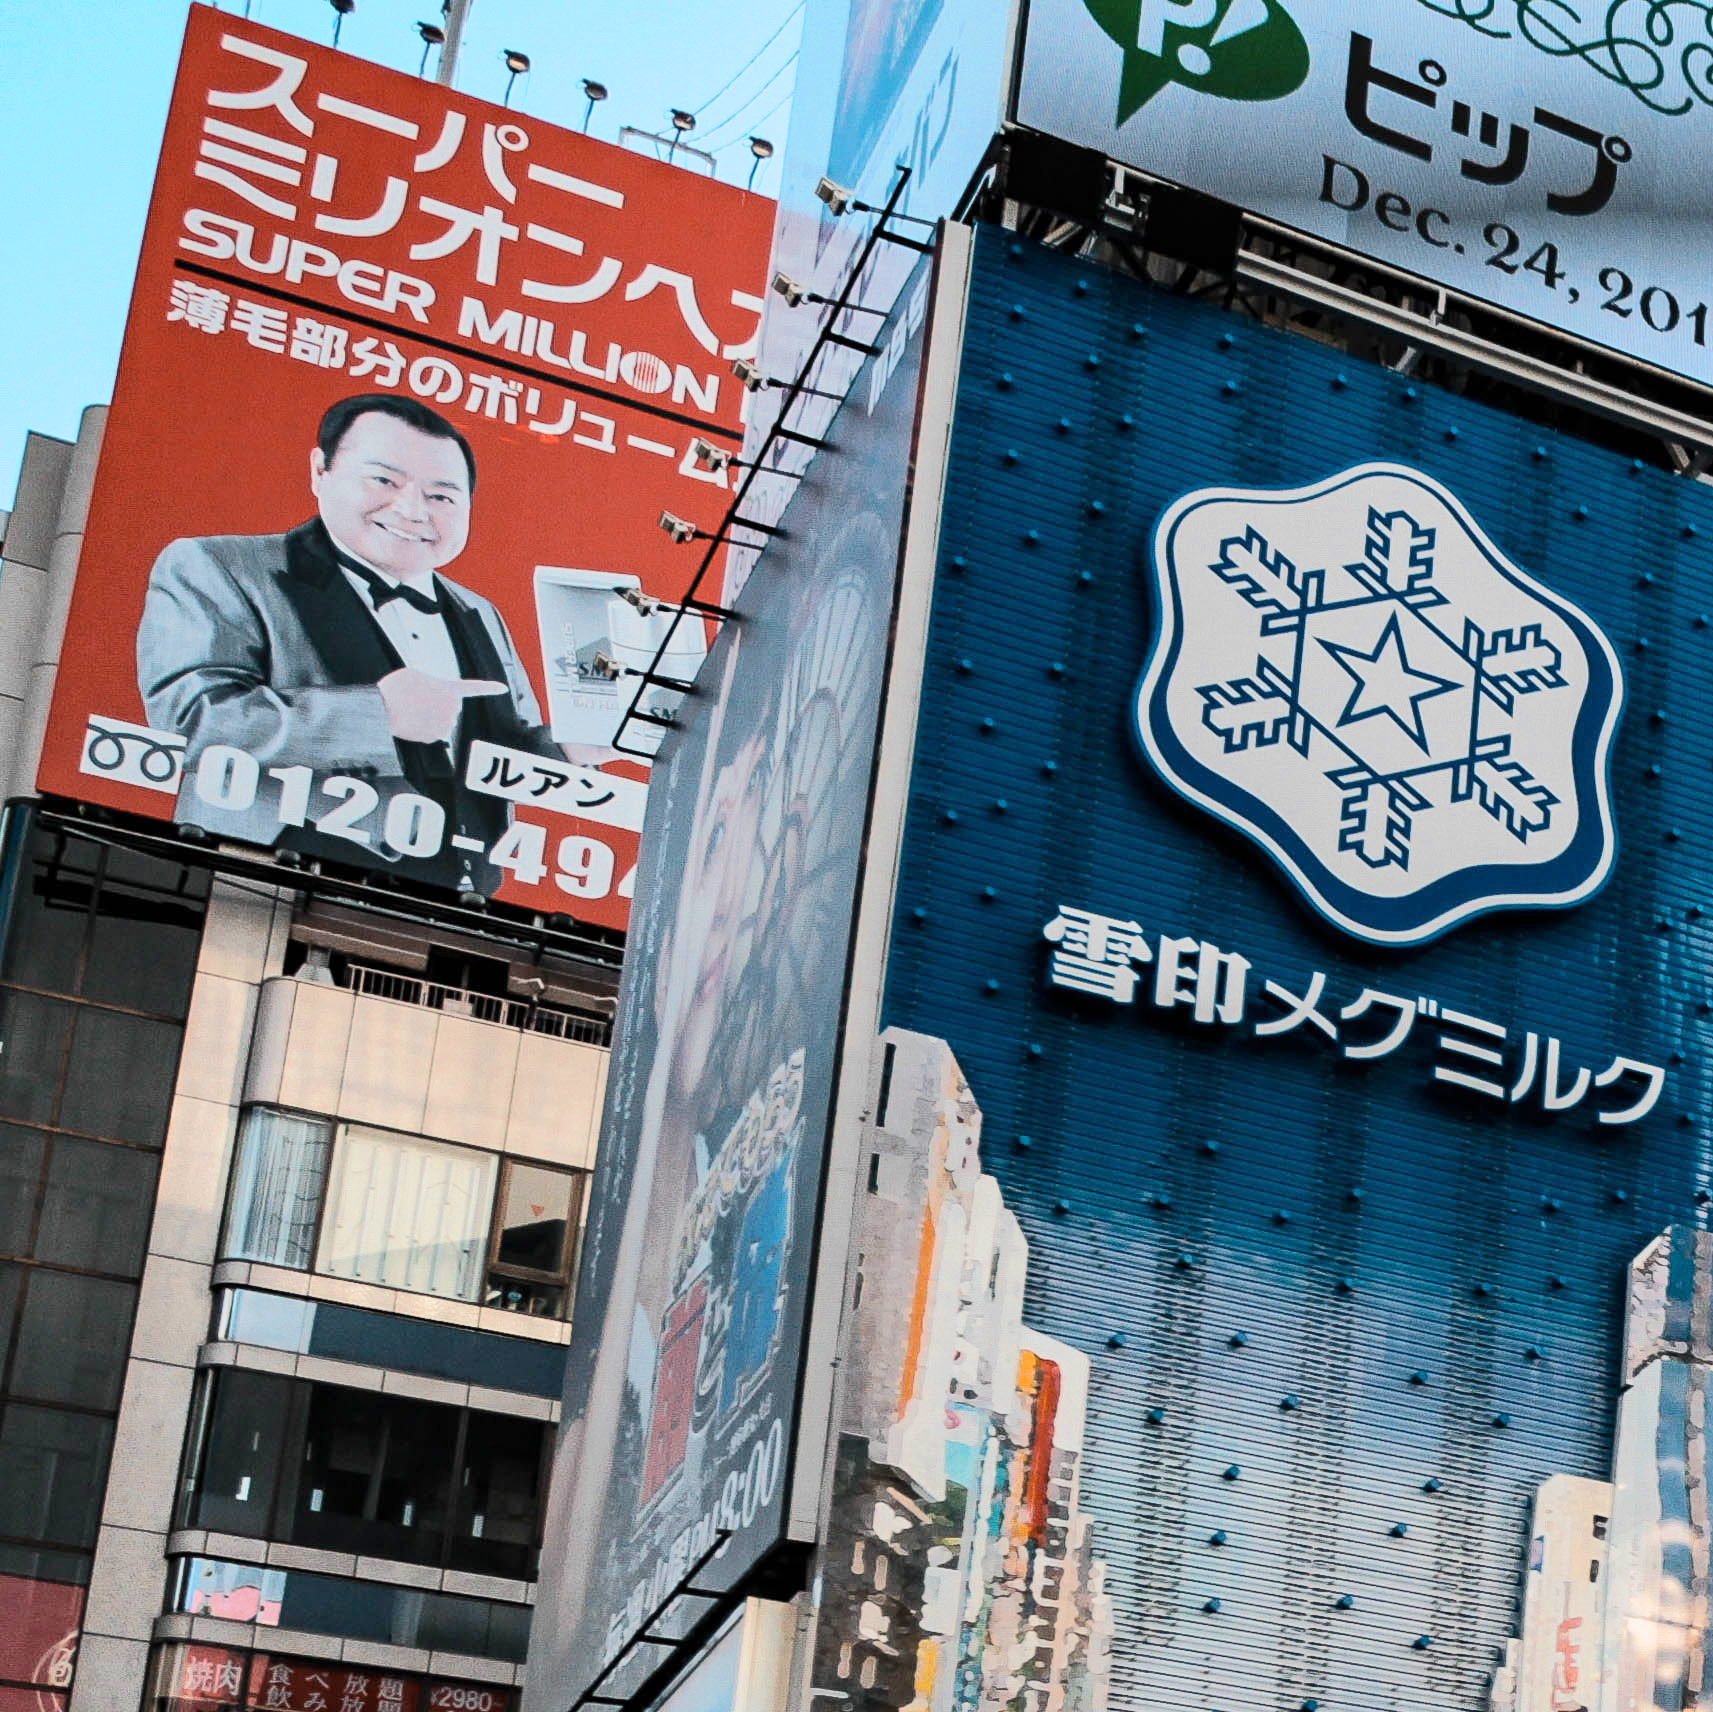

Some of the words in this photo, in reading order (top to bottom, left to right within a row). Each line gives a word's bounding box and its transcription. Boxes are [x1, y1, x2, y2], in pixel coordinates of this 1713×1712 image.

[207, 32, 625, 210] スーパー
[1345, 30, 1633, 216] ピップ
[177, 208, 437, 328] SUPER
[457, 294, 721, 414] MILLION
[1318, 153, 1466, 256] Dec.
[1484, 222, 1580, 305] 24,
[480, 752, 620, 808] ルアン
[1042, 903, 1666, 1125] 雪印メグミルク
[184, 1656, 242, 1697] 焼肉
[268, 1663, 405, 1699] 食べ放題
